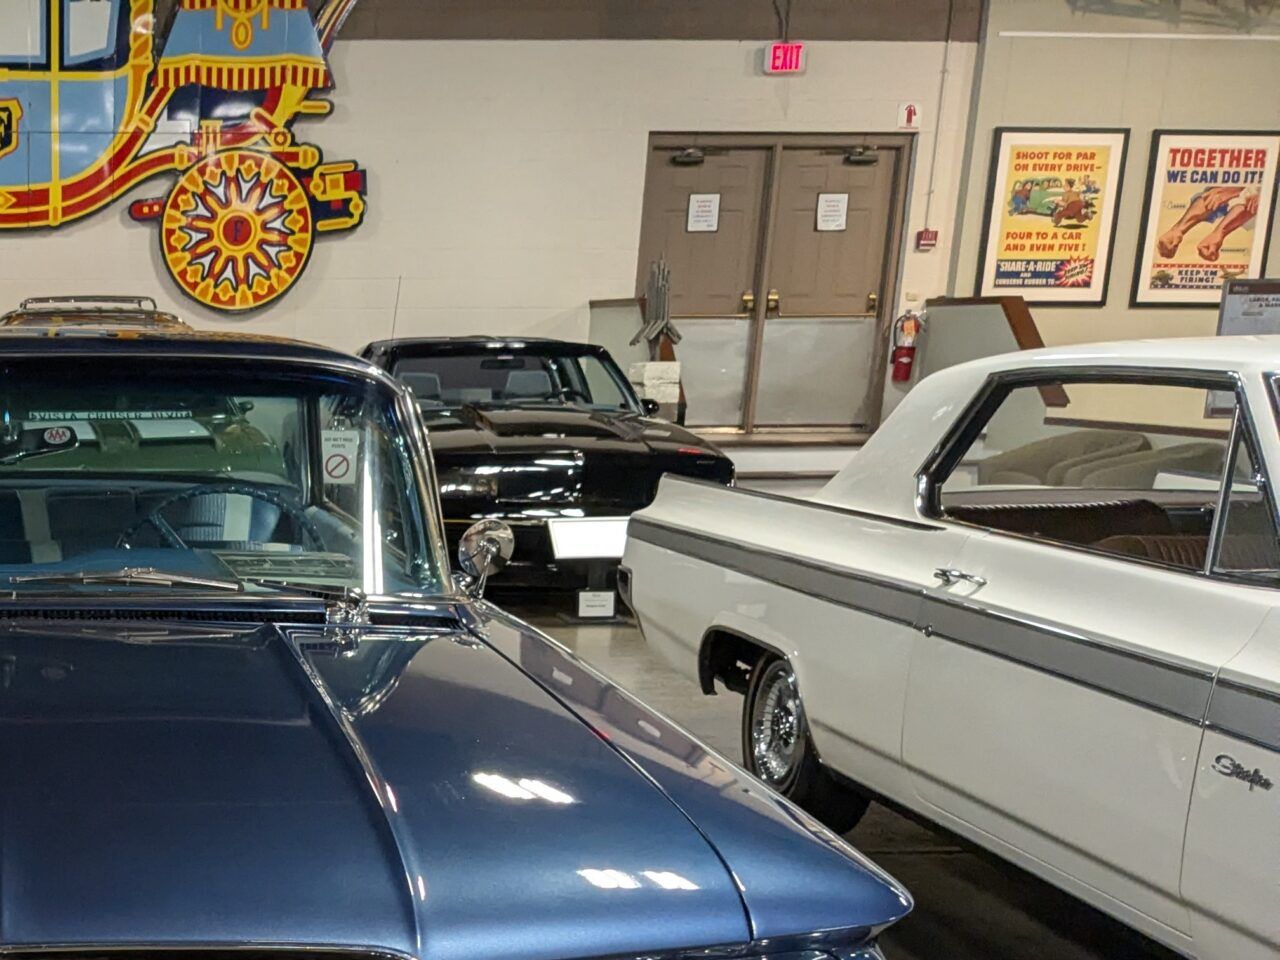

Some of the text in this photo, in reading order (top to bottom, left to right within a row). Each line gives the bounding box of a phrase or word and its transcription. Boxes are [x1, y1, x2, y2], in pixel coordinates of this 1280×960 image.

[772, 45, 802, 70] EXIT
[1016, 152, 1096, 160] SHOOT FOR PAR
[1169, 148, 1266, 168] TOGETHER
[1014, 163, 1028, 172] ON
[1032, 163, 1062, 172] EVERY
[1167, 170, 1264, 184] WE CAN DO IT!
[234, 220, 244, 240] F
[1006, 232, 1082, 240] FOUR TO A CAR
[1004, 243, 1025, 252] AND
[1029, 243, 1054, 252] EVEN
[48, 430, 66, 441] AAA
